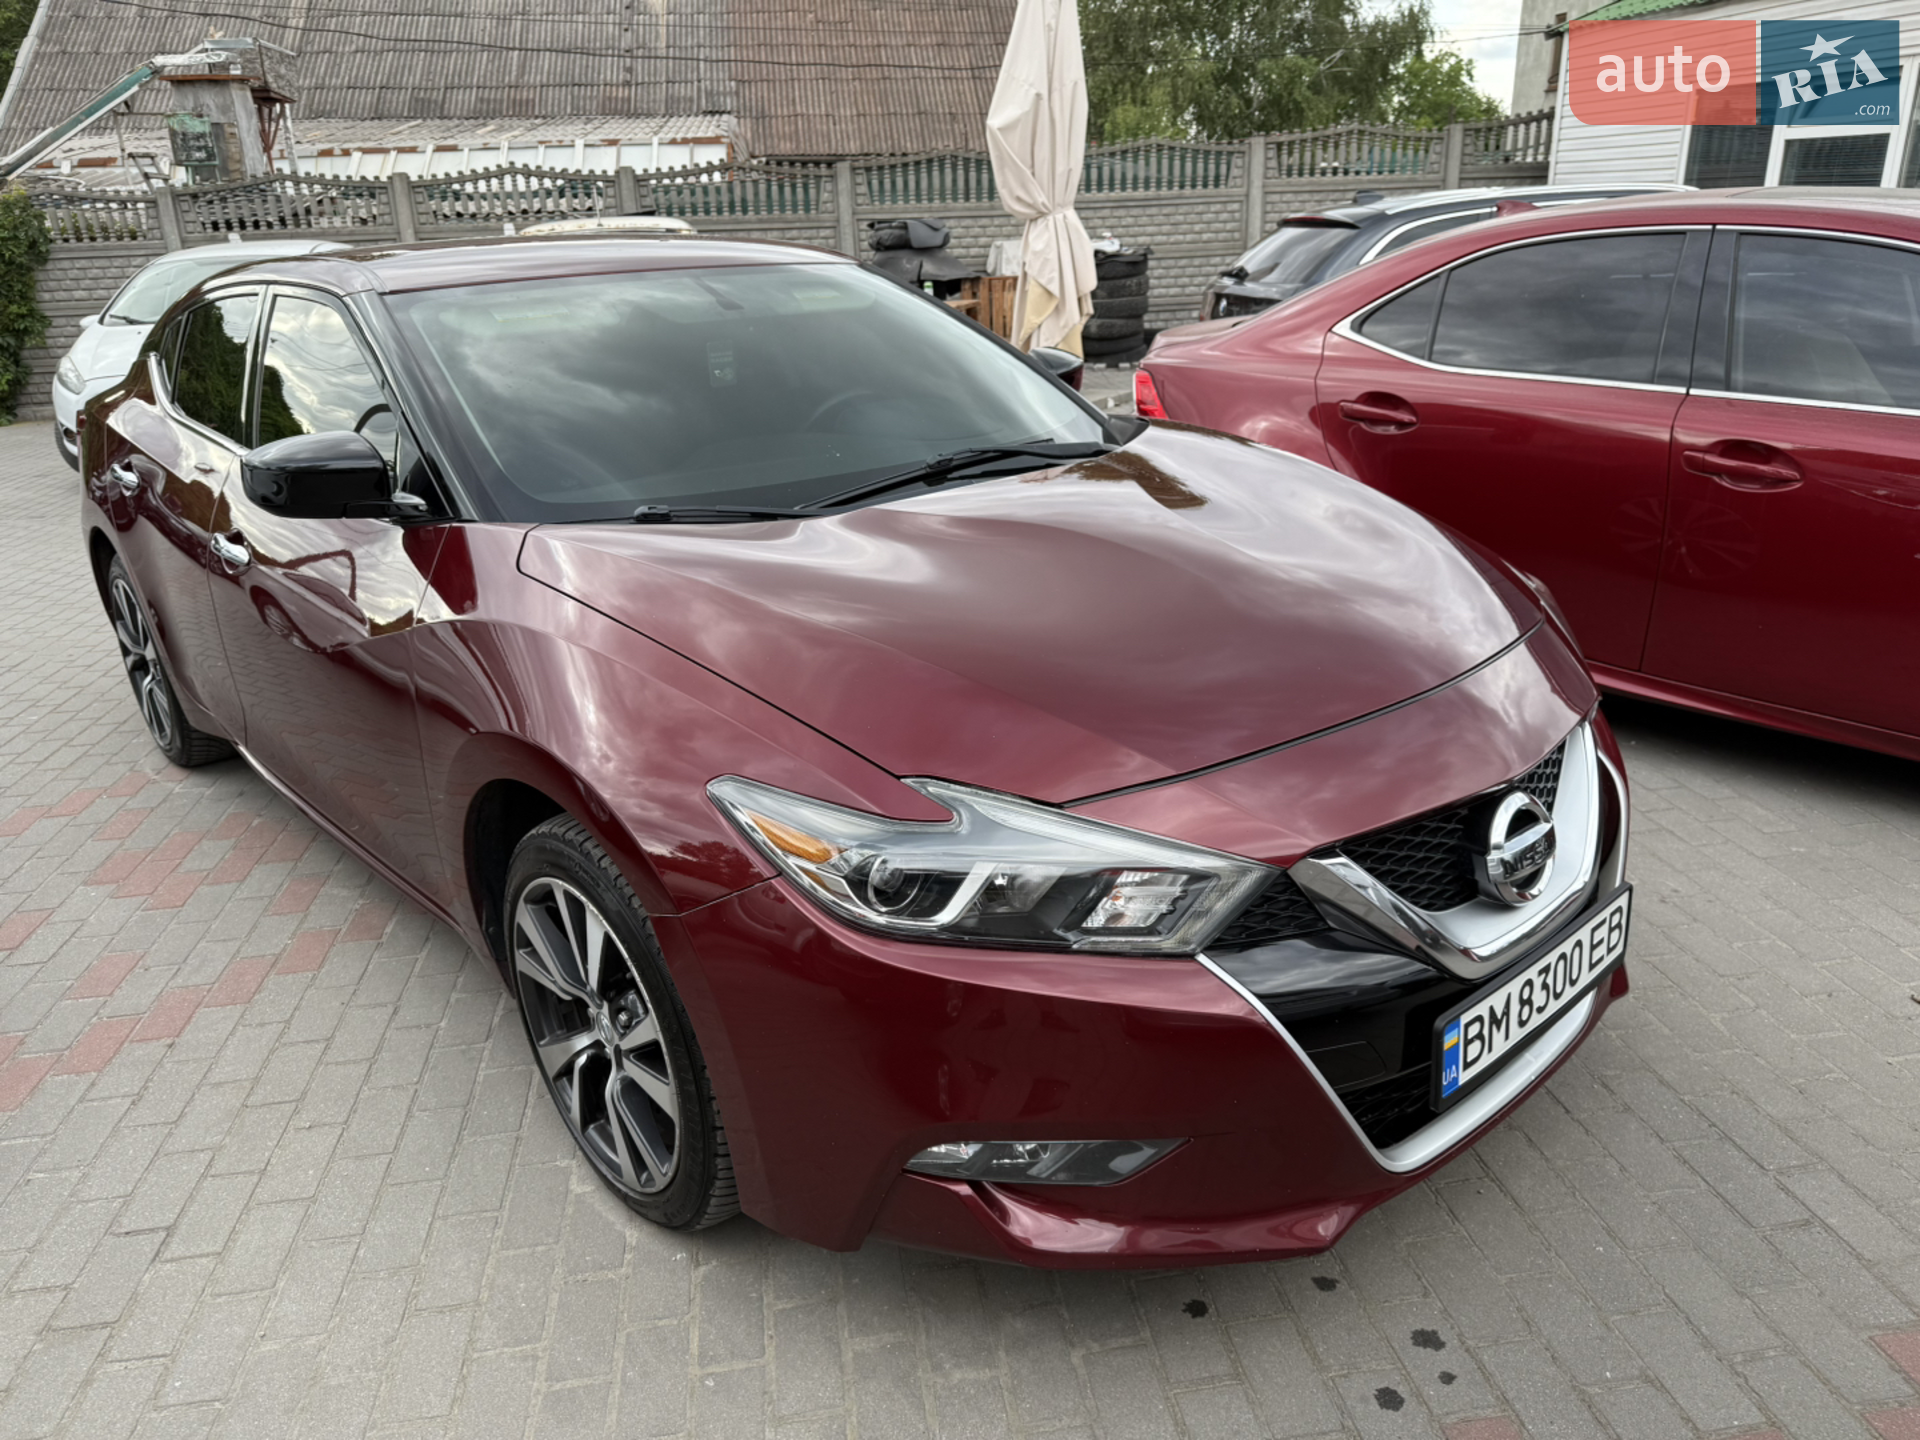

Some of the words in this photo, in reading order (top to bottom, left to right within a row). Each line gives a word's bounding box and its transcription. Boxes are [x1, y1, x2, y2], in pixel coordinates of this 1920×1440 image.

[1503, 836, 1553, 880] NISSA
[1461, 991, 1511, 1073] BM
[1517, 938, 1584, 1029] 8300
[1588, 904, 1624, 974] EB
[1442, 1065, 1459, 1086] UA
